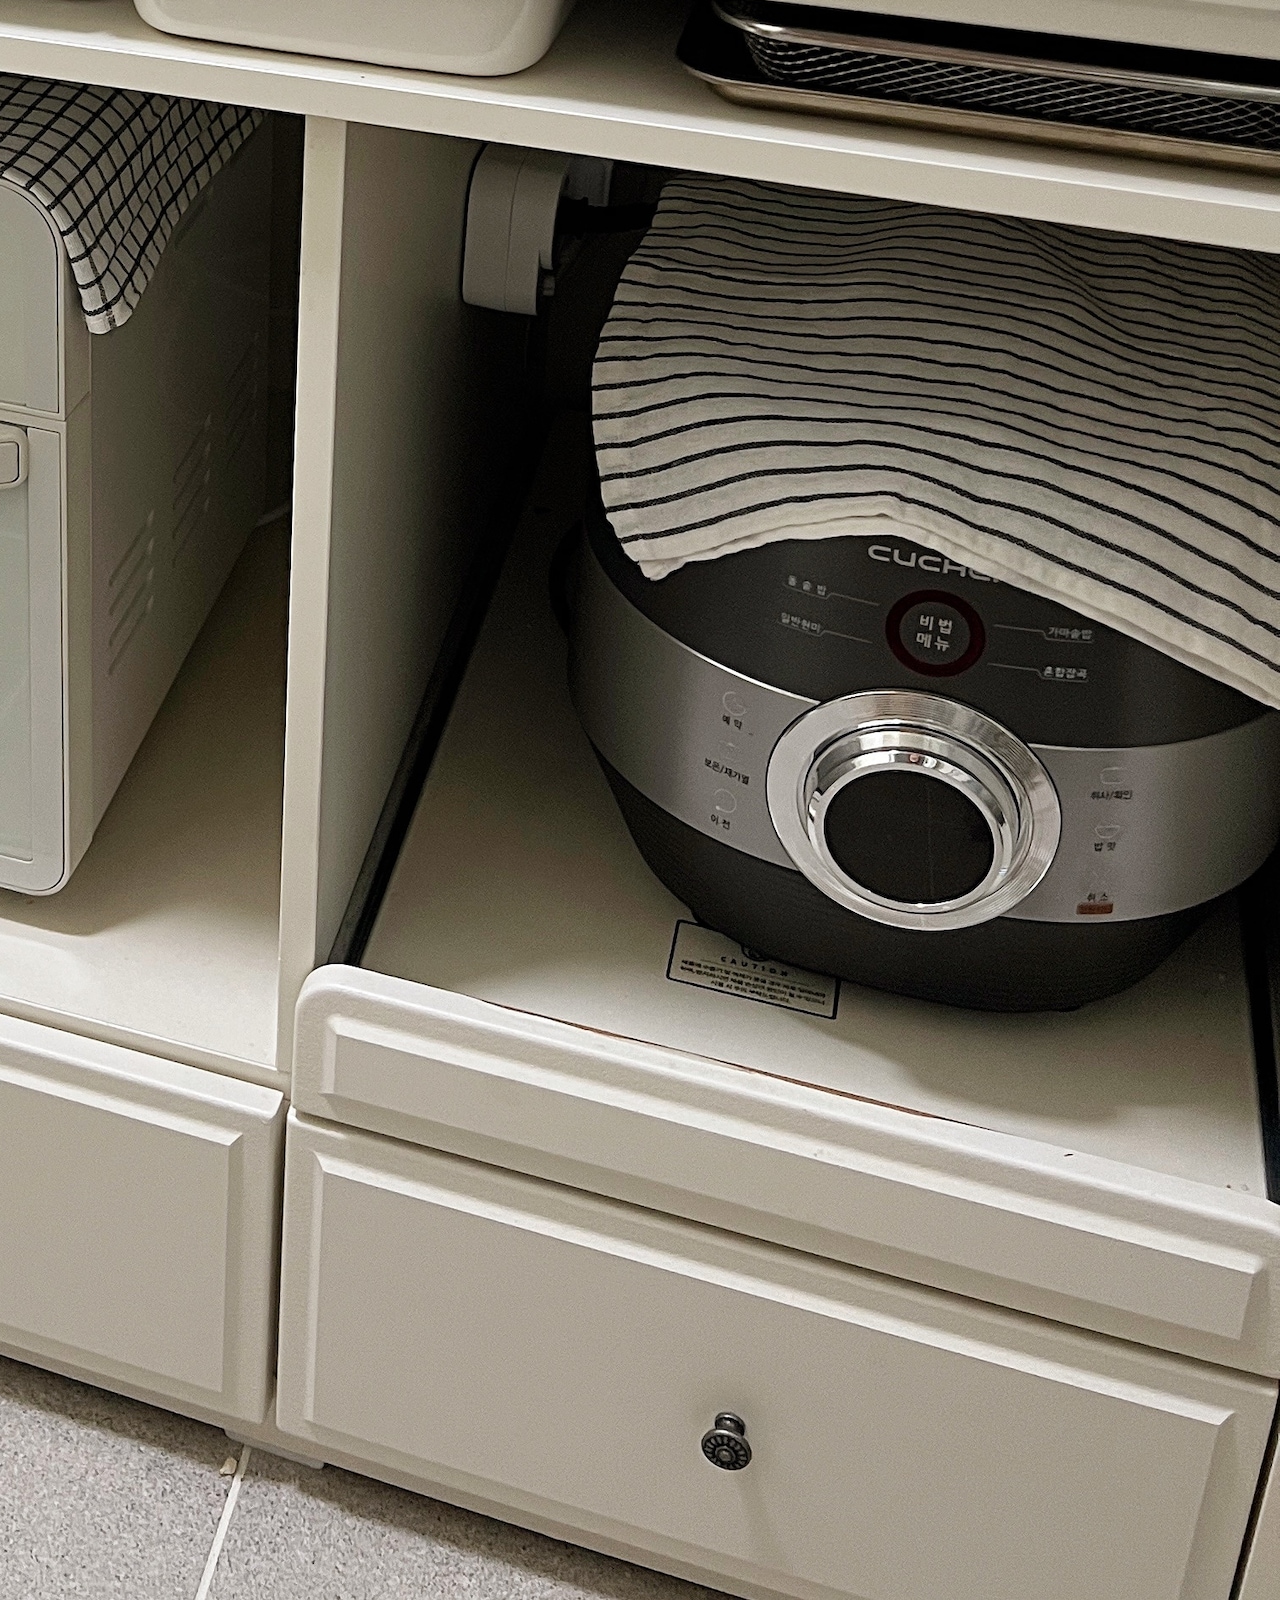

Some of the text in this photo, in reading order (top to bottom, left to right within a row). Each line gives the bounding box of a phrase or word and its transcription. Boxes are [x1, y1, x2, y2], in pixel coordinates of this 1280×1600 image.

[919, 614, 953, 635] 비법
[916, 632, 950, 652] 메뉴
[710, 814, 731, 830] 이전
[721, 955, 789, 977] CAUTION
